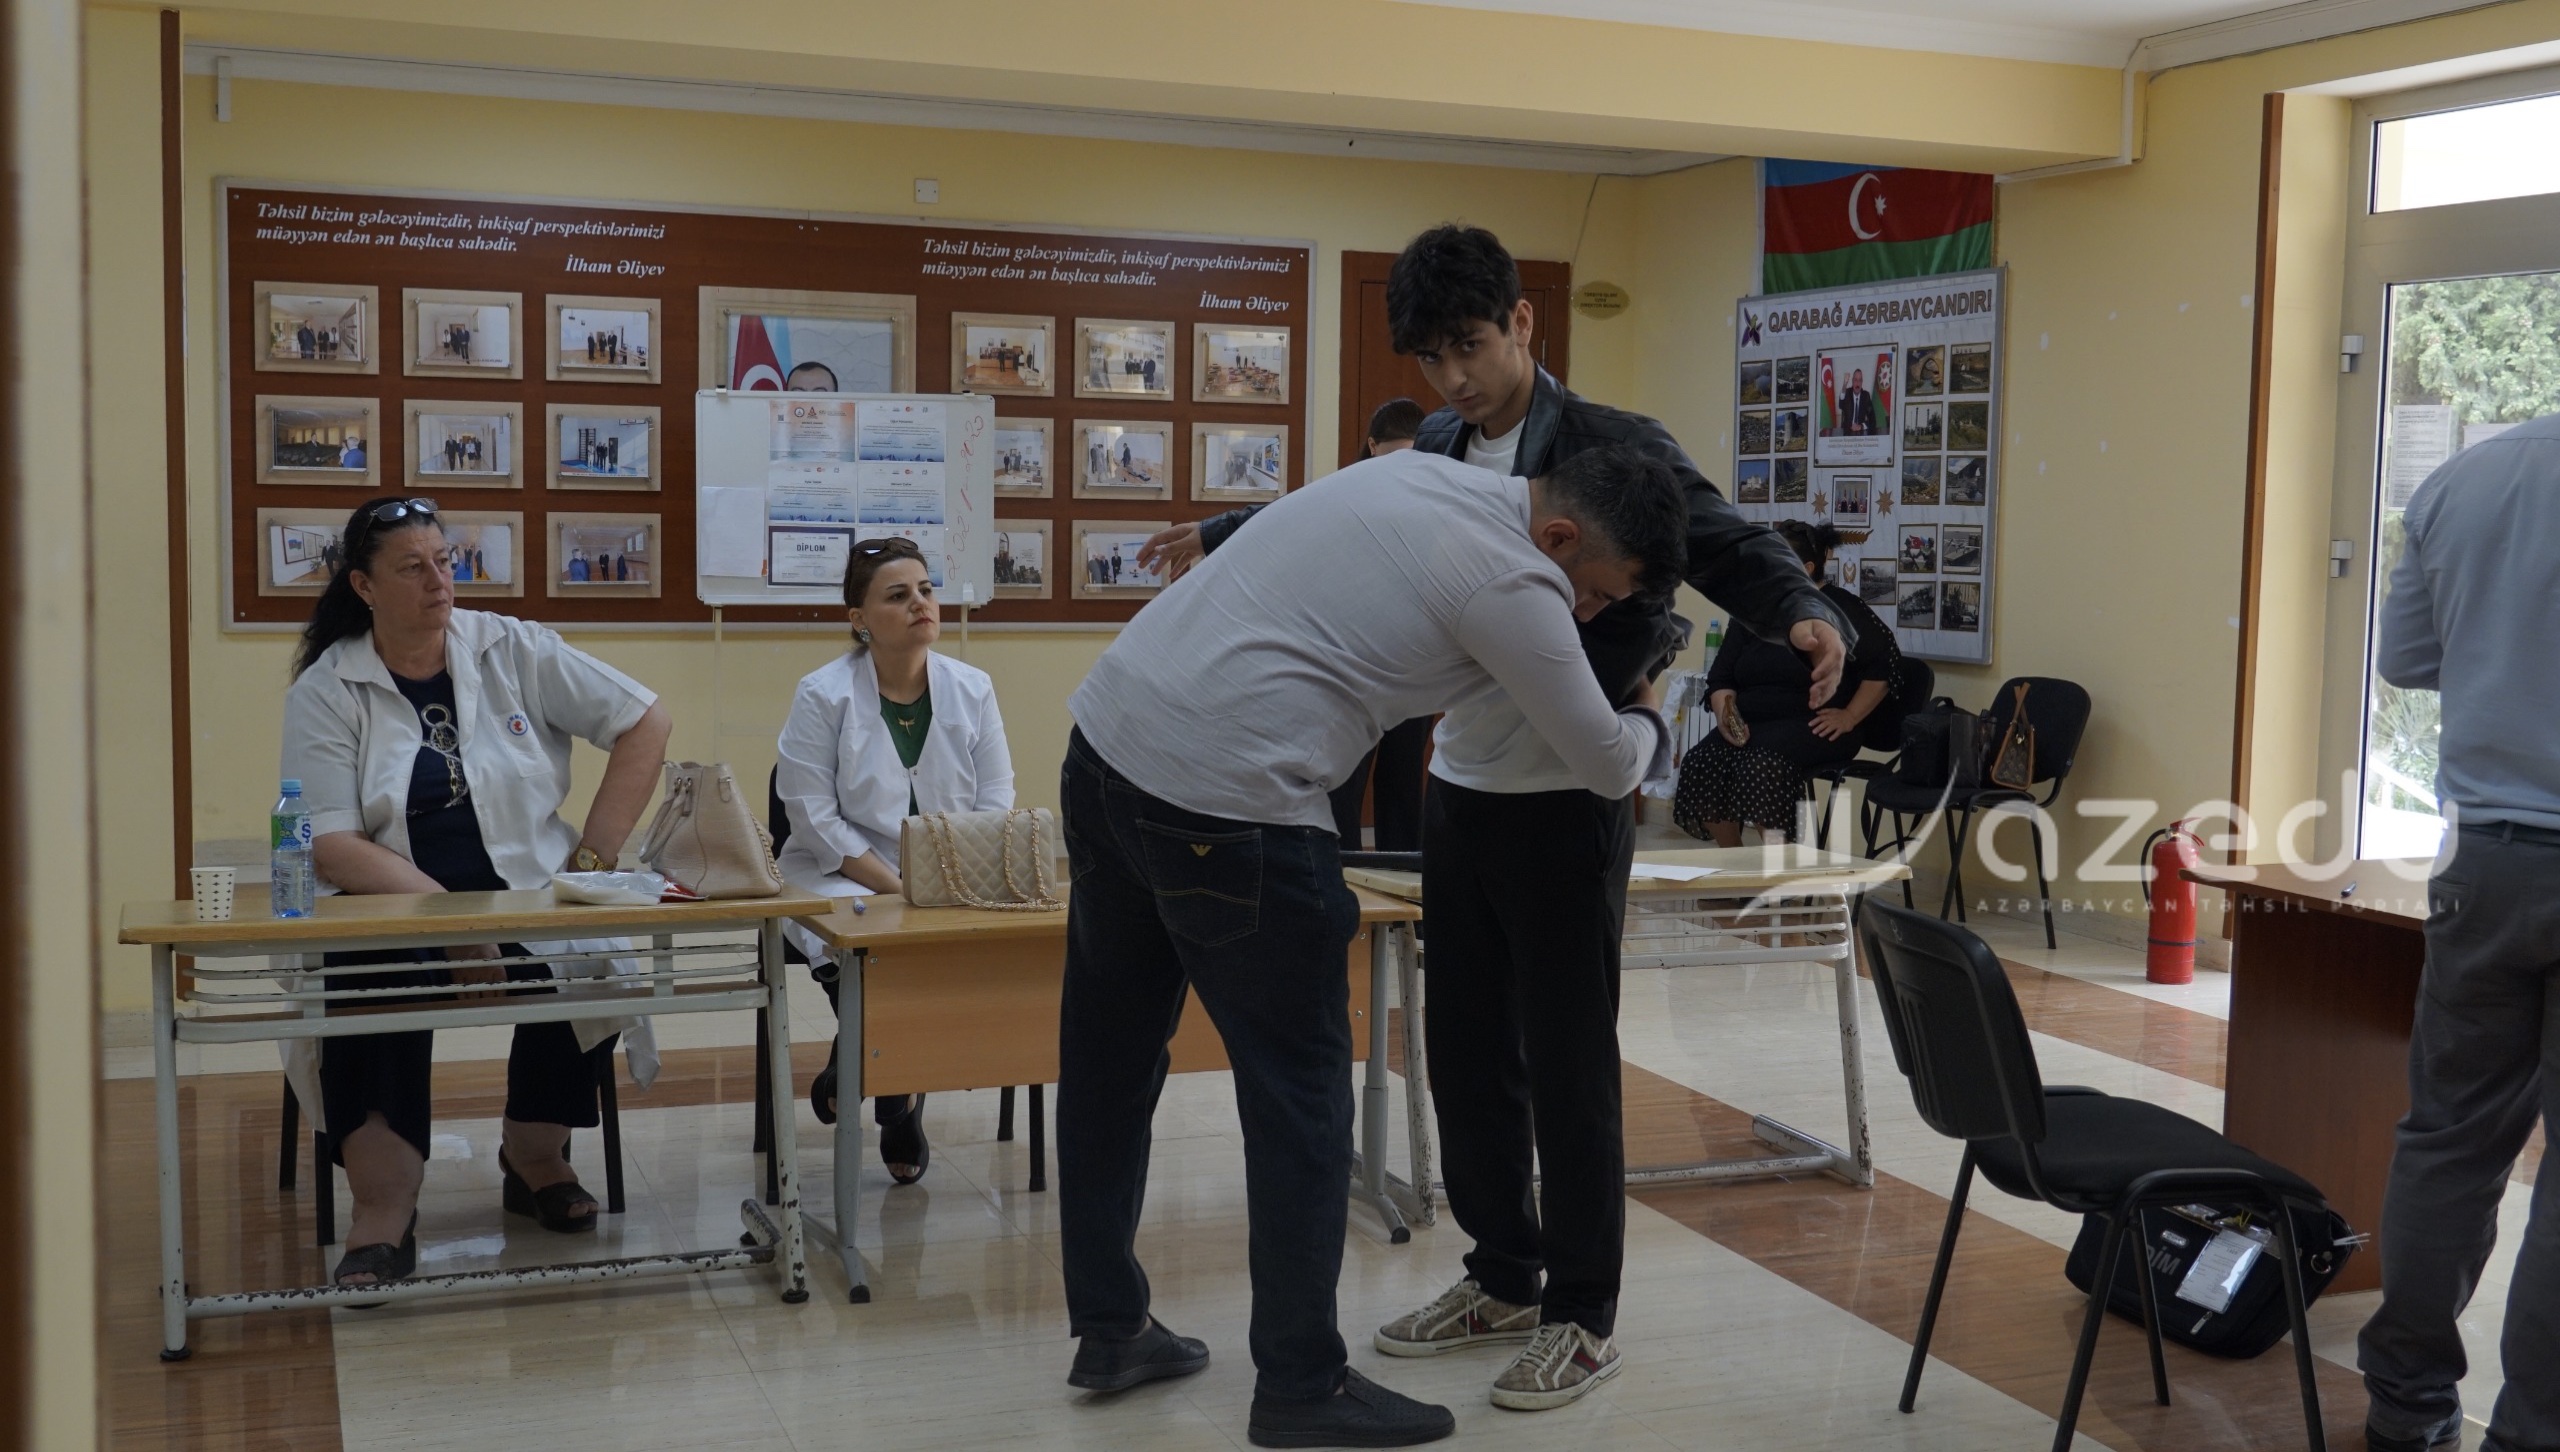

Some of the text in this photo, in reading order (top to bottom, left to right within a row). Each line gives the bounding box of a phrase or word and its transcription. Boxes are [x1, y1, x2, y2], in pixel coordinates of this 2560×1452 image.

[257, 203, 666, 240] Təhsil bizim gələcəyimizdir, inkişaf perspektivlərimizi
[256, 226, 518, 252] müəyyən edən ən başlıca sahədir.
[564, 253, 666, 278] İlham Əliyev
[923, 239, 1291, 274] Təhsil bizim gələcəyimizdir, inkişaf perspektivlərimizi
[922, 261, 1157, 286] müəyyən edən ən başlıca sahədir.
[1199, 289, 1290, 314] İlham Əliyev
[1768, 288, 1993, 334] QARABAĞ AZƏRBAYCANDIR!
[796, 542, 826, 552] DİPLOM
